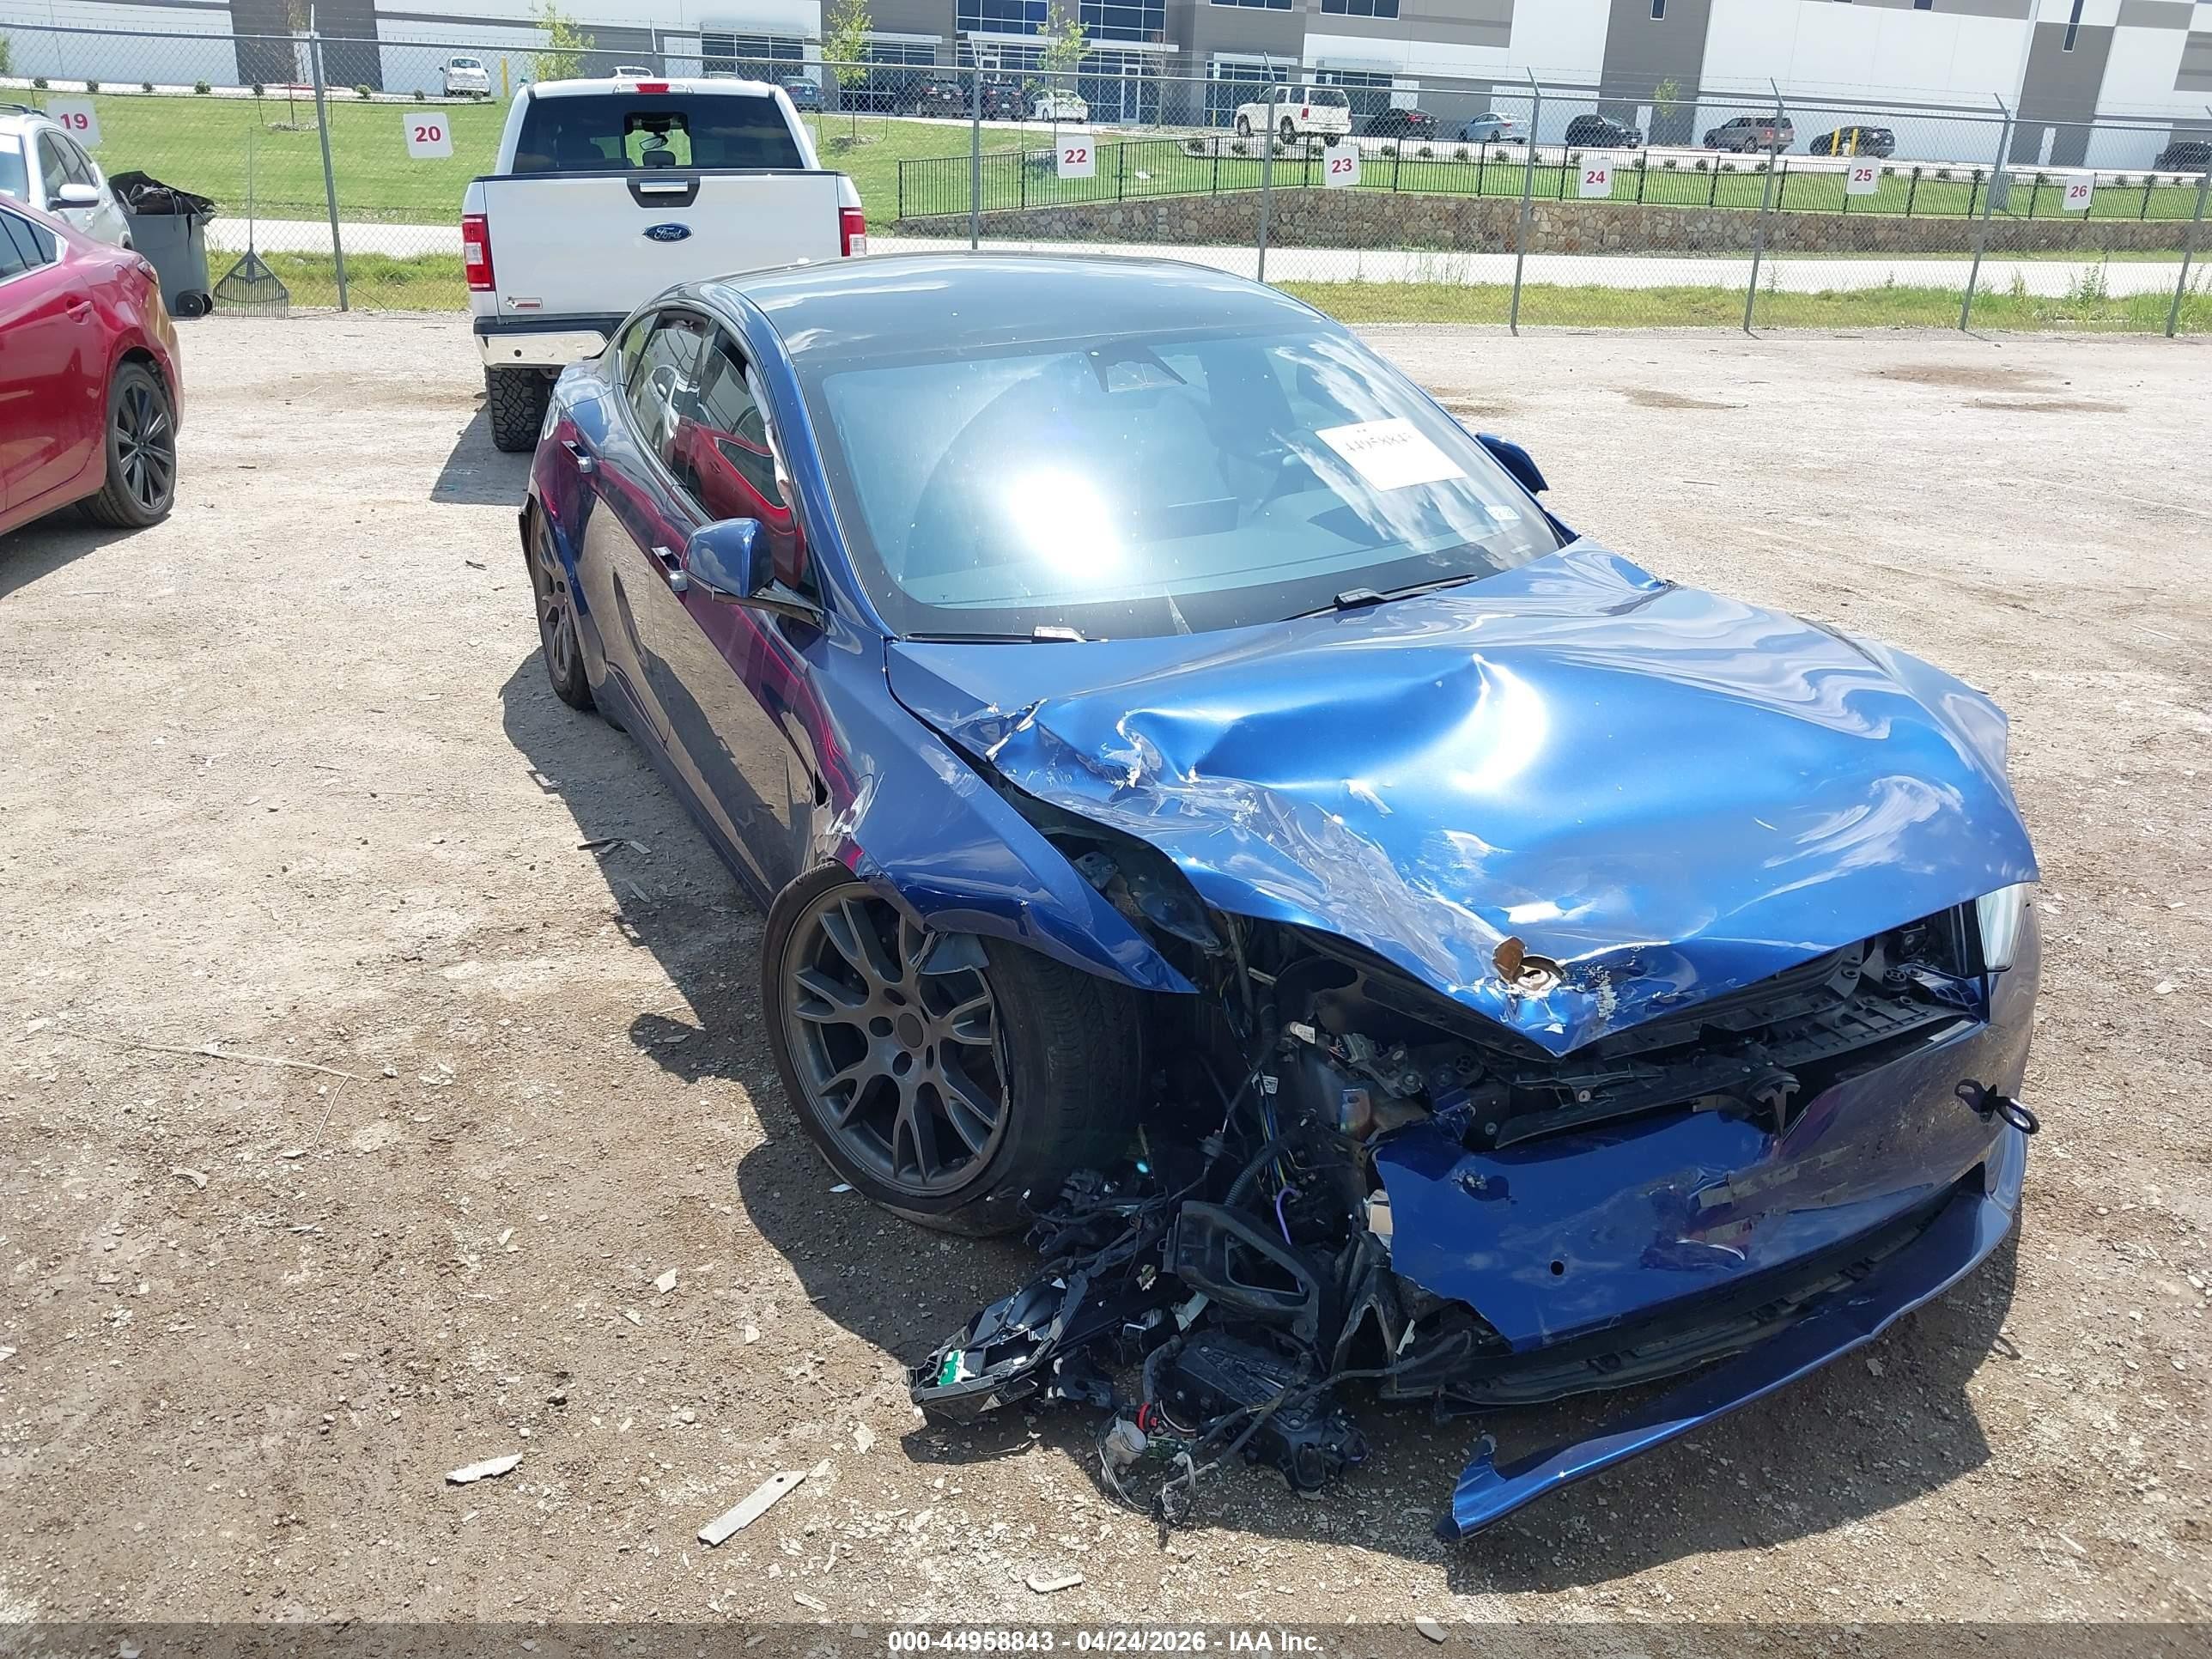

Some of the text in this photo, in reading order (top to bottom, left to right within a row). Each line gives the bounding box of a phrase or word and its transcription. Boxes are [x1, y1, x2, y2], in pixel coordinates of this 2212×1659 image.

[60, 113, 88, 130] 19
[414, 125, 441, 143] 20
[1064, 149, 1087, 164] 22
[1332, 158, 1352, 173] 23
[1586, 171, 1606, 184] 24
[1854, 168, 1873, 182] 25
[2070, 185, 2087, 198] 26
